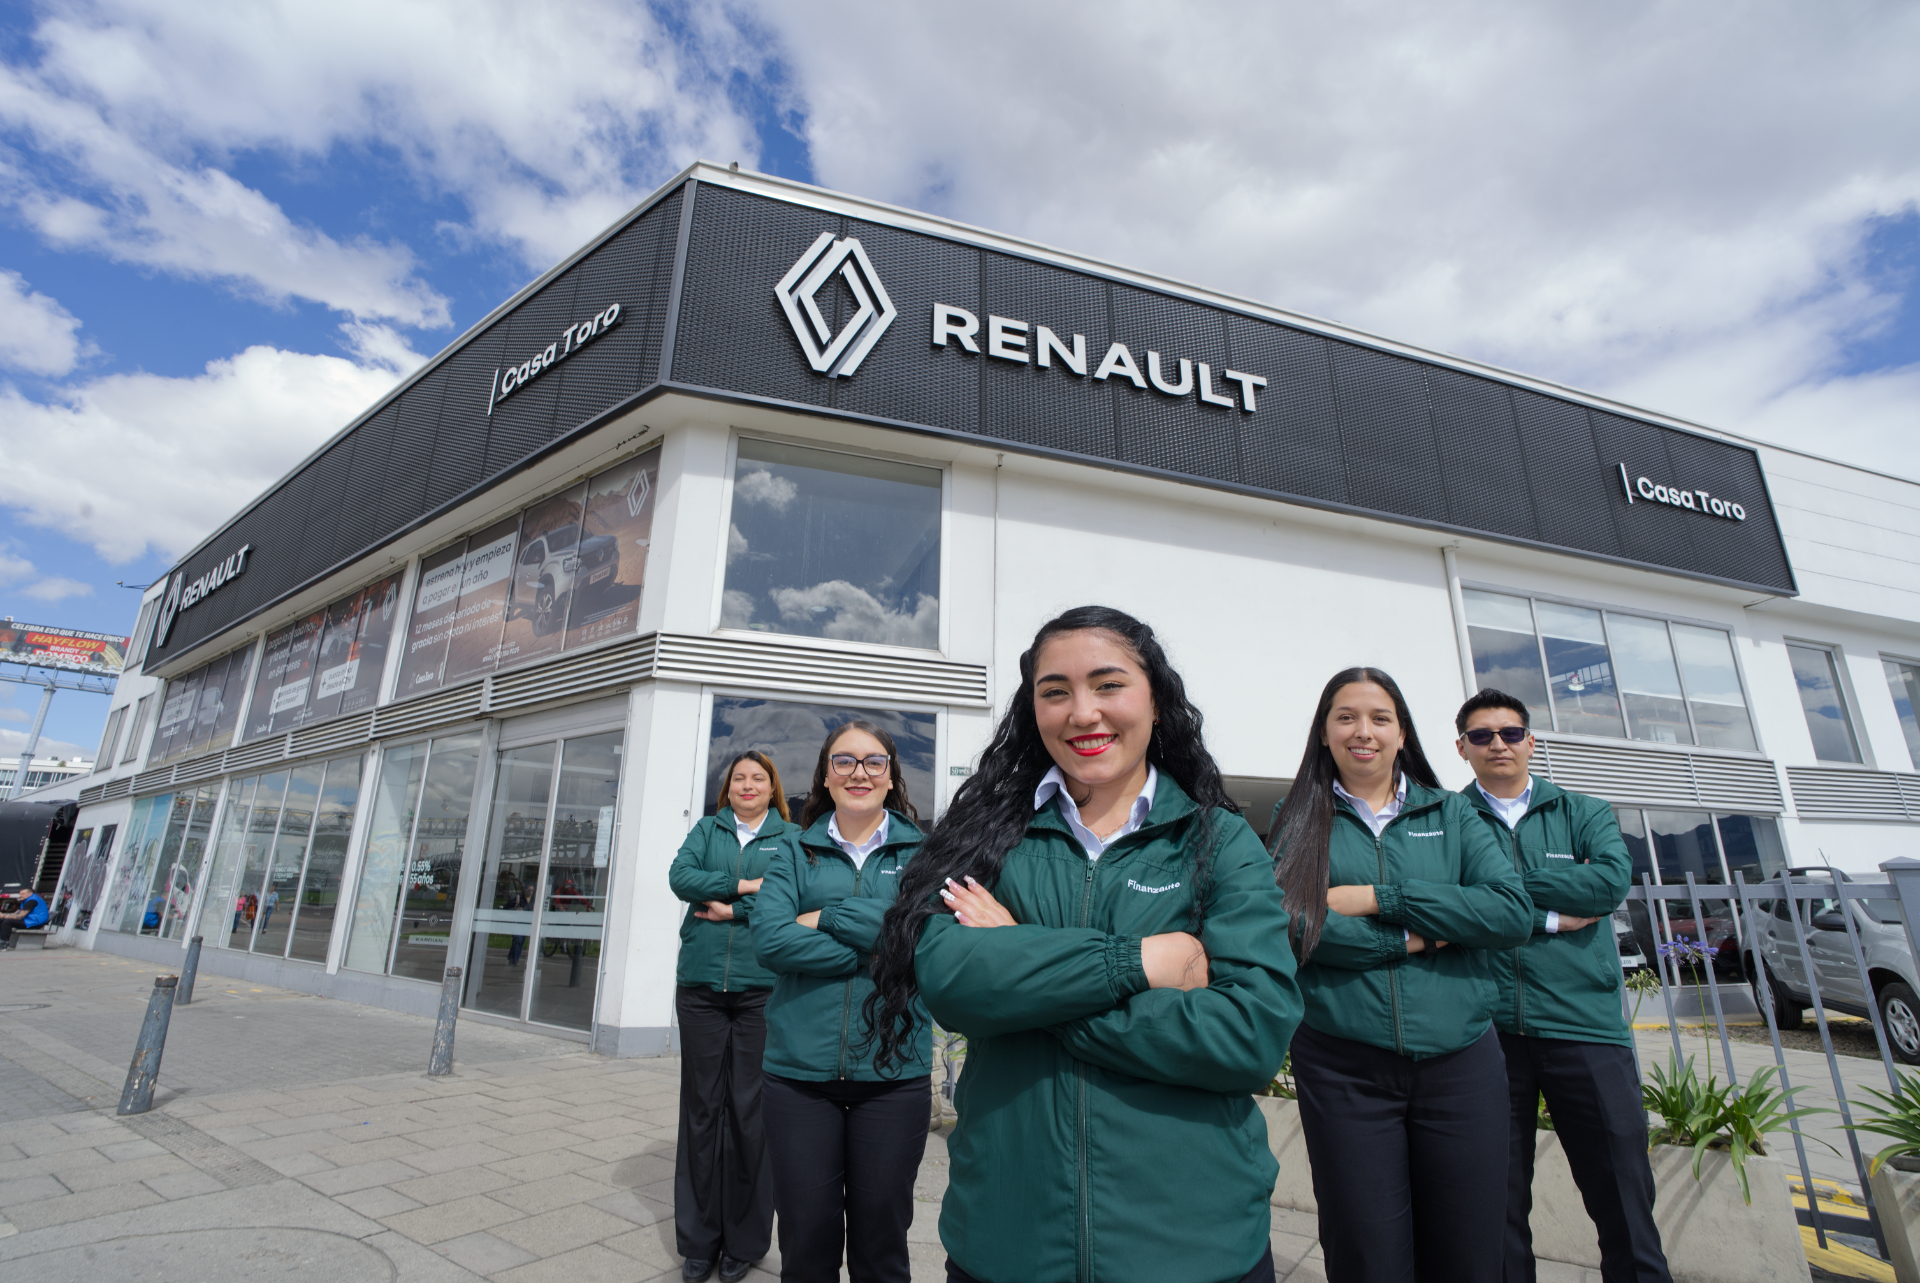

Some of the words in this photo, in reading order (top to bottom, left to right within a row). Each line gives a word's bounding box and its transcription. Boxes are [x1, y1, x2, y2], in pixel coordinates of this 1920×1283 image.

[501, 341, 558, 394] Casa
[562, 303, 620, 354] Toro
[932, 302, 1267, 412] RENAULT
[1636, 476, 1695, 509] Casa
[1694, 490, 1746, 521] Toro
[179, 543, 250, 612] RENAULT
[425, 566, 455, 588] estrena
[475, 542, 512, 566] empieza
[422, 596, 428, 605] a
[427, 585, 451, 606] pagar
[472, 569, 489, 585] año
[11, 622, 44, 633] CELEBRA
[44, 627, 58, 635] ESO
[59, 629, 75, 637] QUE
[84, 632, 103, 640] HACE
[421, 616, 443, 633] meses
[481, 597, 491, 610] de
[31, 634, 100, 650] HAYFLOW
[49, 645, 80, 654] BRANDY
[411, 635, 434, 654] gracia
[433, 631, 444, 644] sin
[443, 625, 464, 640] cota
[411, 860, 431, 872] 0.55%
[417, 872, 434, 885] años
[1127, 878, 1181, 894] Finanzauto
